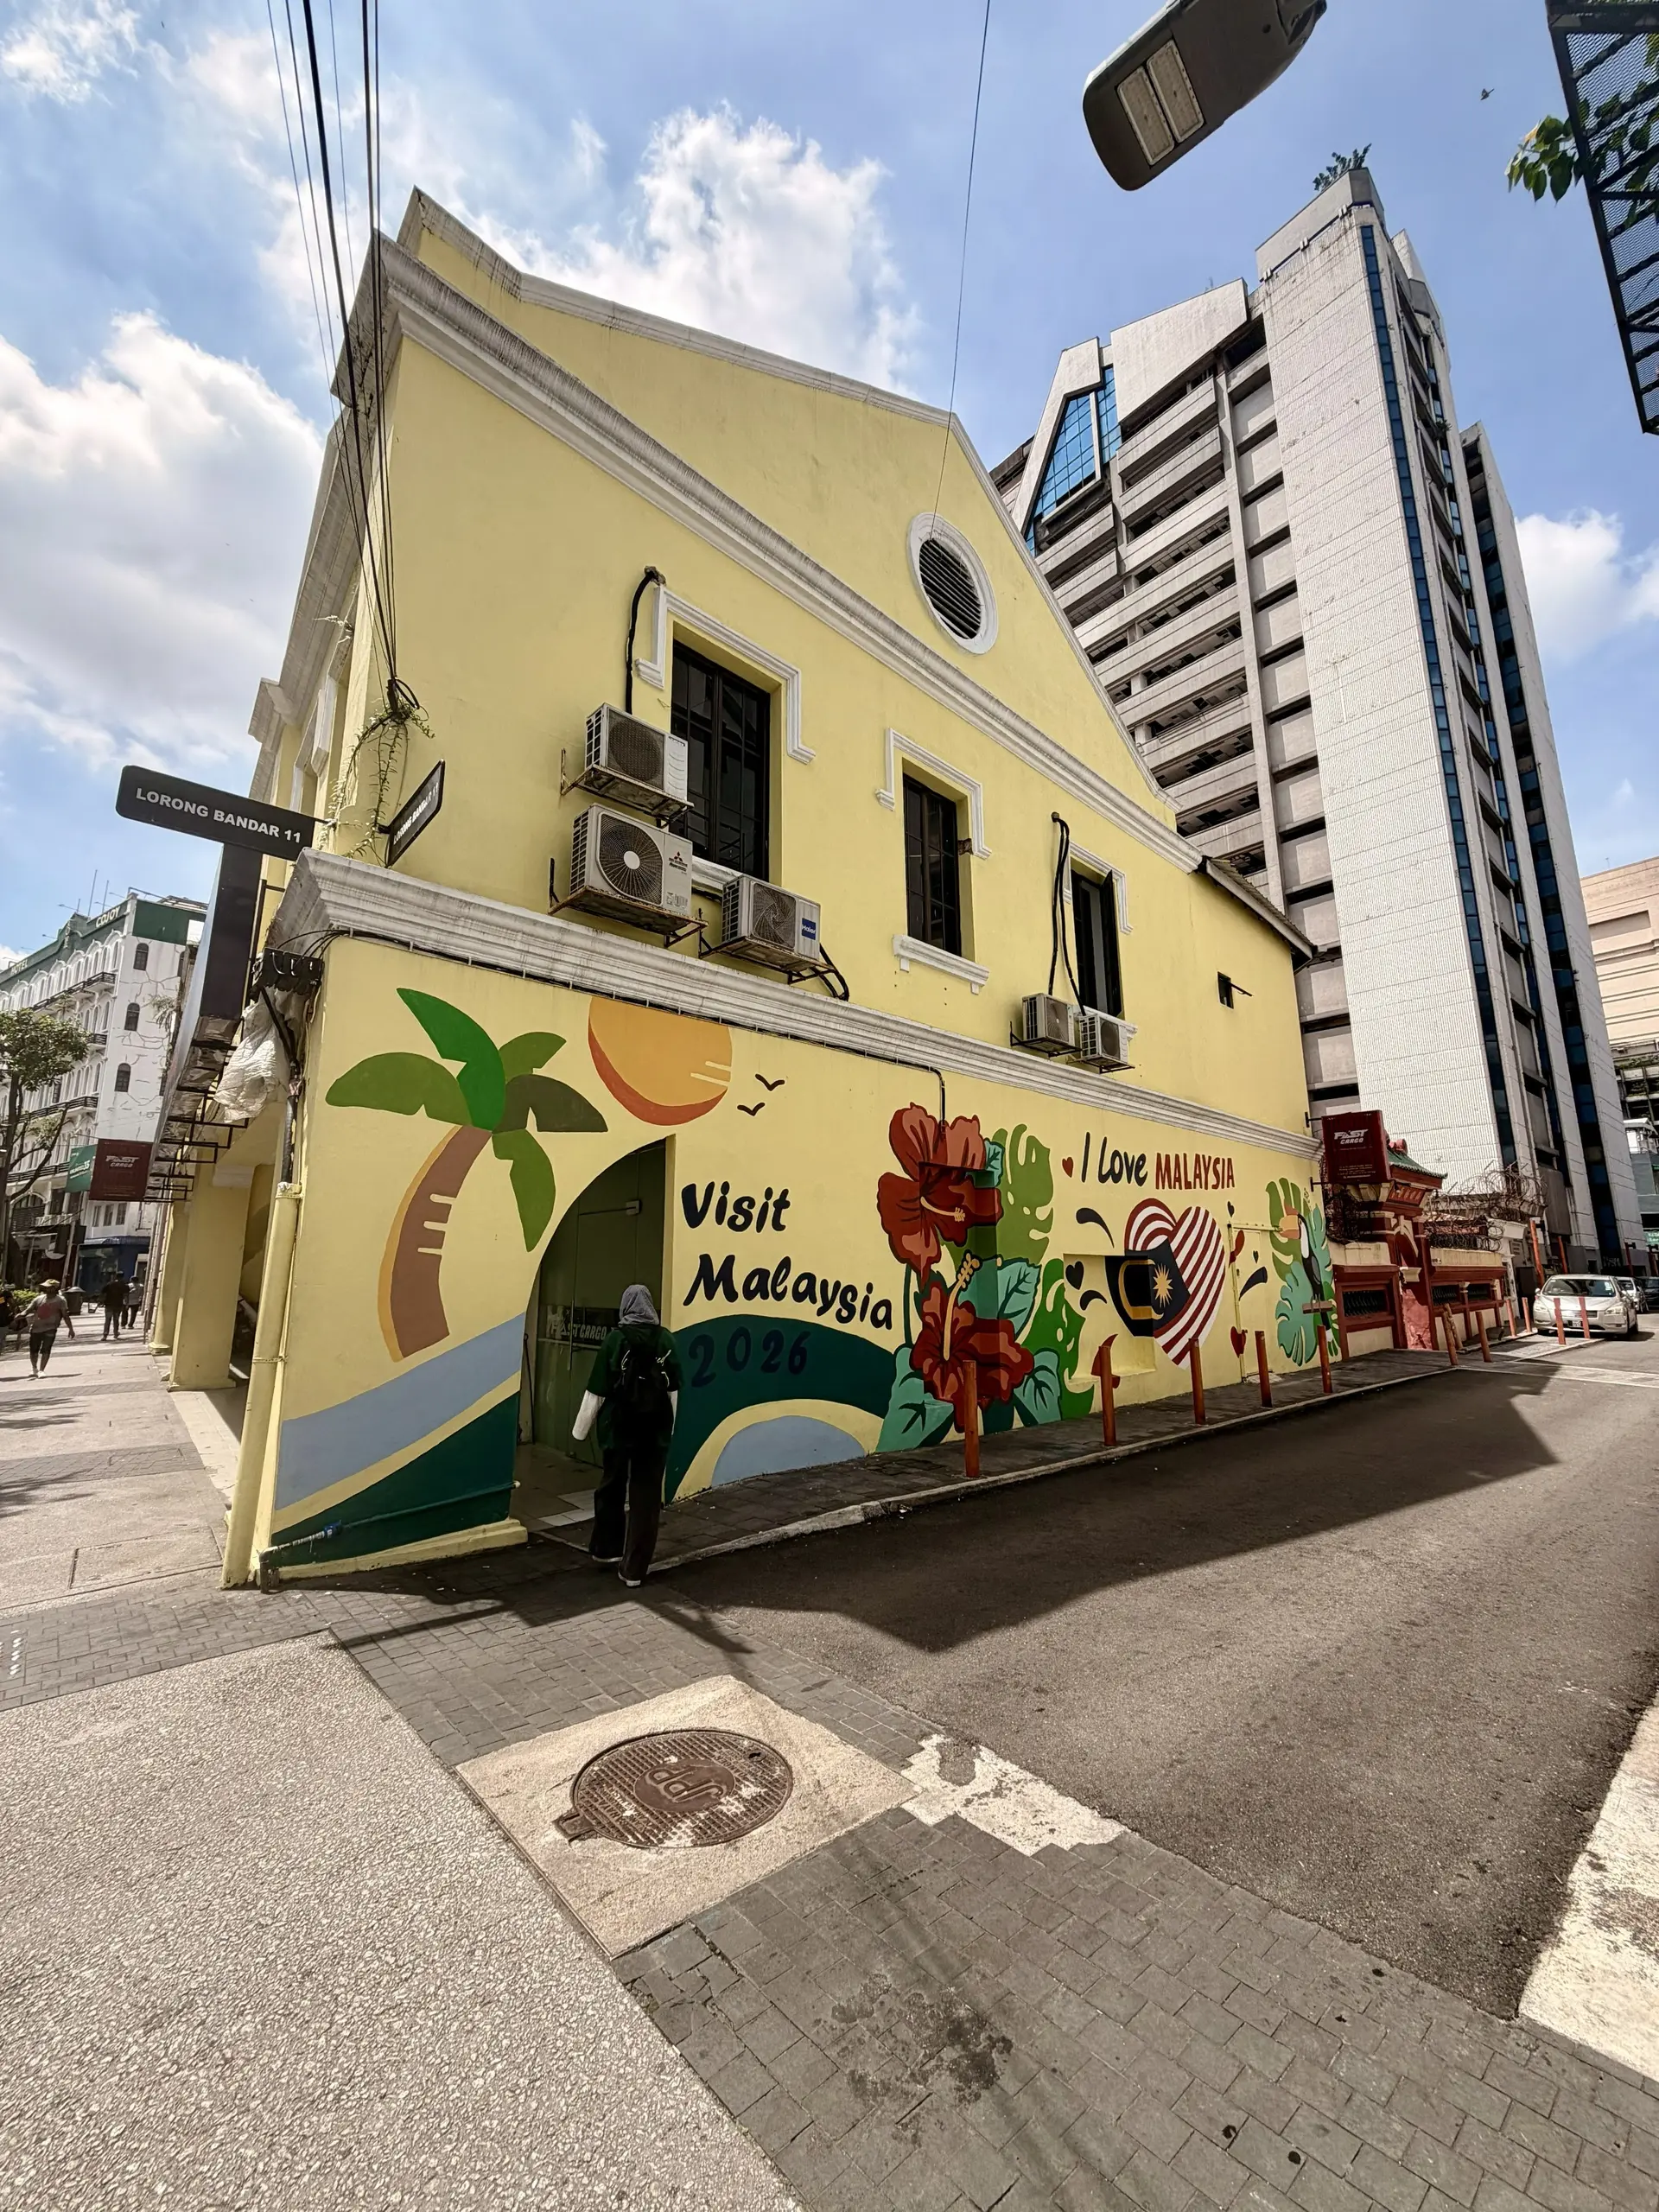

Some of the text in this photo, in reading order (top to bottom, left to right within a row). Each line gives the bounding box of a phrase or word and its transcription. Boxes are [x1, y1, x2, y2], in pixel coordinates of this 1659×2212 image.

[136, 787, 302, 844] LORONG BANDAR 11
[95, 906, 121, 928] COJOY
[801, 925, 816, 934] Haier
[1082, 1131, 1236, 1191] I Love MALAYSIA
[1333, 1128, 1369, 1141] FAST
[681, 1180, 791, 1234] Visit
[683, 1253, 893, 1331] Malaysia
[688, 1325, 811, 1388] 2026
[646, 1765, 726, 1804] JPP
